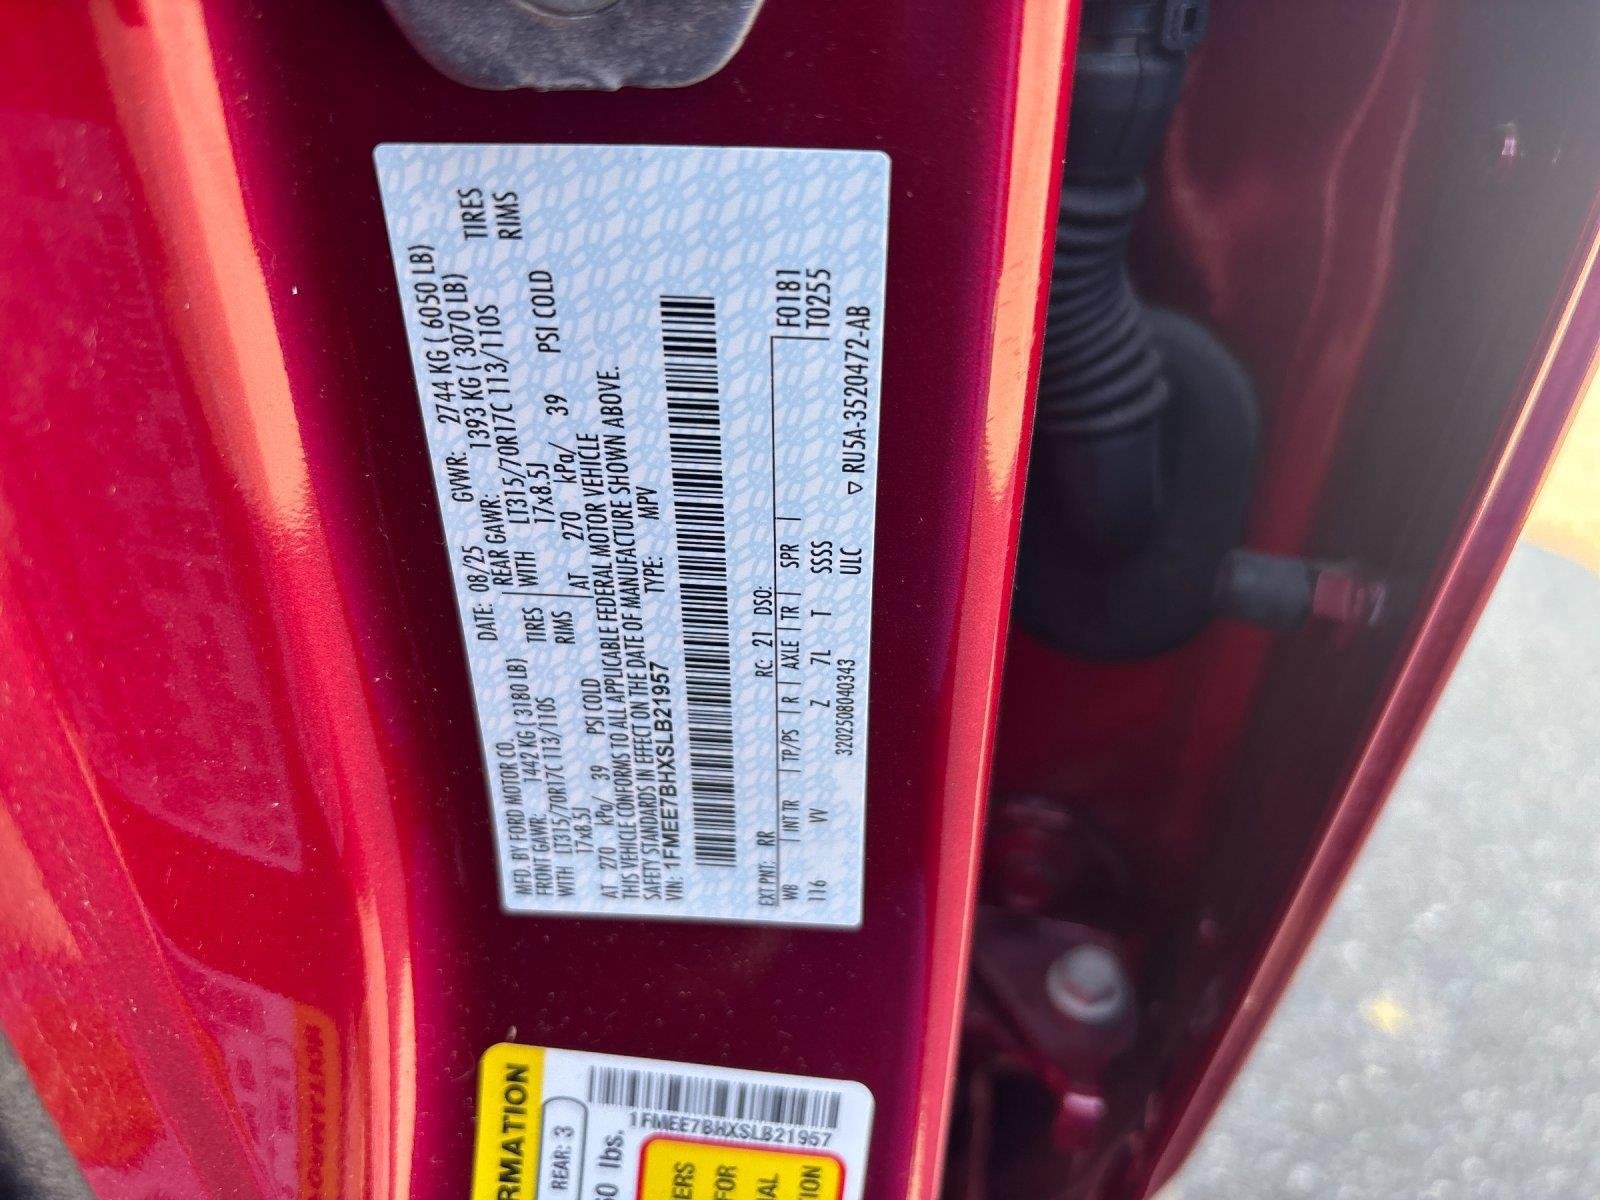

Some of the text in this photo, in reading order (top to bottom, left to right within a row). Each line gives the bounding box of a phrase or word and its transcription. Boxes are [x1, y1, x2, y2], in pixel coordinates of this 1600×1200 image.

[458, 188, 488, 241] TIRES
[492, 190, 523, 240] RIMS
[408, 245, 436, 275] LB)
[414, 282, 444, 329] 6050
[442, 273, 468, 303] LB)
[776, 269, 801, 328] F0181
[806, 269, 831, 329] T0255
[447, 311, 477, 357] 3070
[426, 350, 452, 374] KG
[432, 382, 461, 424] 2744
[459, 377, 484, 400] KG
[842, 306, 870, 473] RU5A-3520472-AB
[463, 407, 491, 448] 1393
[474, 304, 539, 587] WITH LT315/70R17C 113/110S
[528, 270, 590, 590] AT 270 kPa/ 39 PSI COLD
[446, 452, 474, 502] GVWR:
[526, 462, 556, 523] 17x8.5J
[479, 494, 507, 544] GAWR:
[635, 486, 665, 593] TYPE: MPV
[488, 549, 513, 586] REAR
[780, 544, 800, 568] SPR
[811, 540, 833, 574] SSSS
[840, 547, 862, 575] ULC
[462, 545, 498, 641] DATE: 08/25
[781, 606, 800, 620] TR
[522, 607, 546, 643] TIRES
[551, 611, 576, 644] RIMS
[596, 366, 662, 900] SAFETY STANDARDS IN EFFECT ON THE DATE OF MANUFACTURE SHOWN ABOVE.
[752, 586, 773, 678] RC: 21 DSO:
[506, 658, 528, 679] LB)
[576, 433, 640, 900] THIS VEHICLE CONFORMS TO ALL APPLICABLE FEDERAL MOTOR VEHICLE
[781, 640, 800, 670] AXLE
[811, 650, 831, 666] 7L
[510, 684, 533, 716] 3180
[835, 659, 855, 756] 3202508040343
[517, 731, 537, 748] KG
[779, 729, 802, 762] TP/PS
[520, 752, 542, 783] 1442
[650, 662, 684, 900] VIN: 1FMEE7BHXSLB21957
[535, 697, 575, 896] WITH LT315/70R17C 113/110S
[581, 678, 619, 899] AT 270 kPa/ 39 PSI COLD
[496, 738, 533, 895] MFD. BY FORD MOTOR CO.
[530, 814, 550, 852] GAWR:
[572, 807, 594, 854] 17x8.5J
[782, 800, 799, 832] INT TR
[533, 858, 552, 895] FRONT
[757, 830, 775, 907] EXT PNT: RR
[782, 884, 799, 900] WB
[808, 879, 828, 901] 116
[598, 1130, 625, 1168] lbs.
[628, 1111, 833, 1147] 1FMEE7BHXSLB21957
[551, 1125, 575, 1190] REAR: 3
